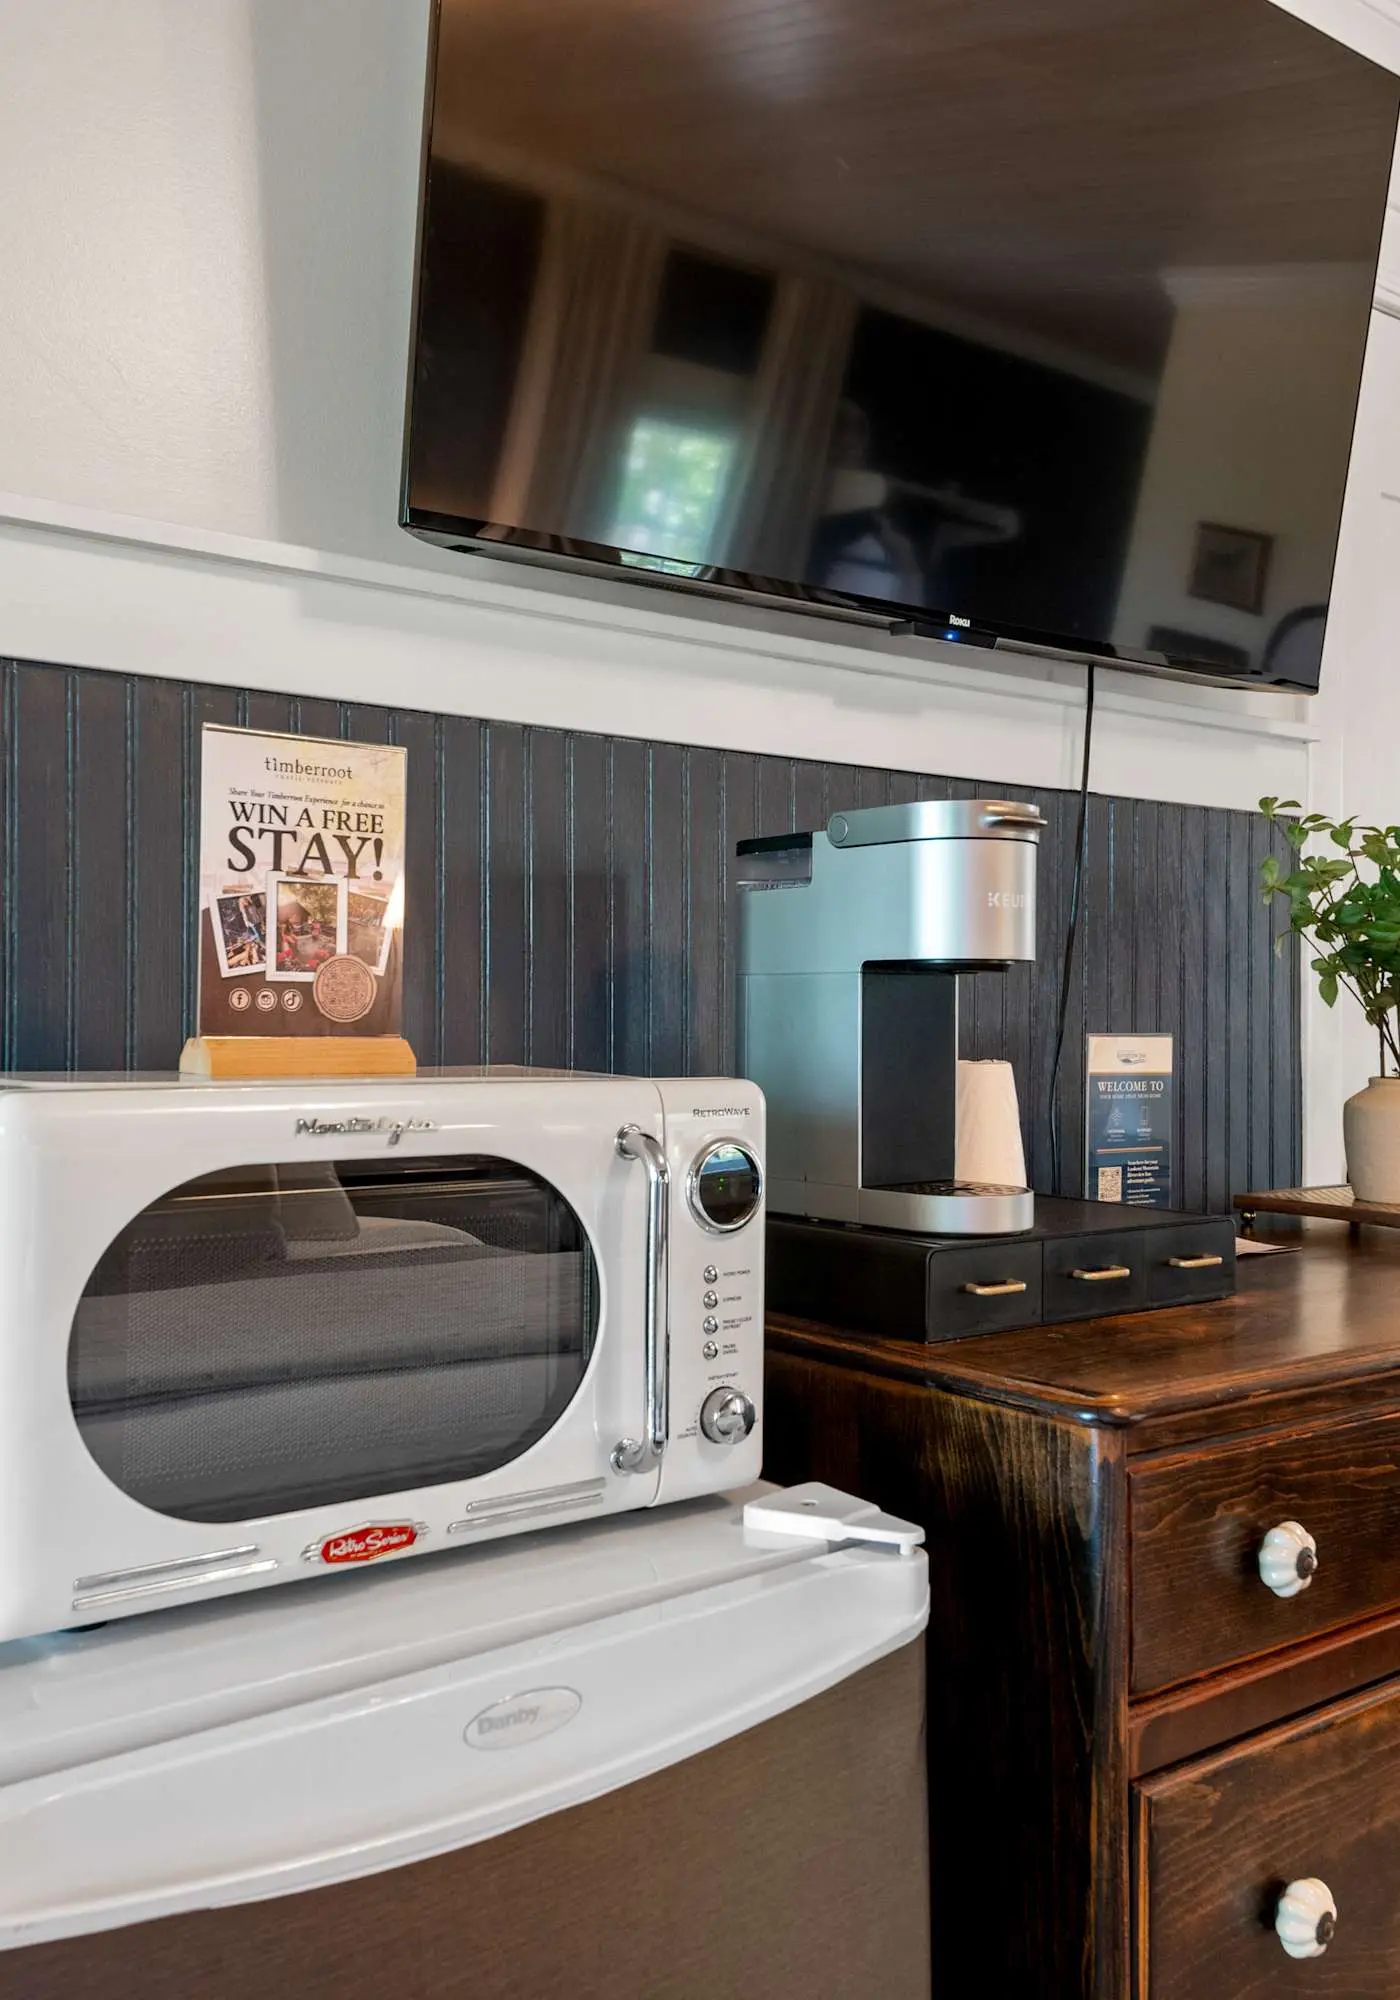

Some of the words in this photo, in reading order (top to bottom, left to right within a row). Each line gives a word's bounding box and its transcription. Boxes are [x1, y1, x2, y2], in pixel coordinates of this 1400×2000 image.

[264, 757, 353, 779] timberroot
[228, 800, 288, 826] WIN
[295, 807, 315, 828] A
[322, 809, 384, 834] FREE
[227, 825, 384, 881] STAY!
[1097, 1081, 1147, 1092] WELCOME
[1150, 1080, 1164, 1091] TO
[329, 1537, 366, 1558] Retro
[364, 1528, 411, 1550] Series
[477, 1705, 541, 1736] Danby
